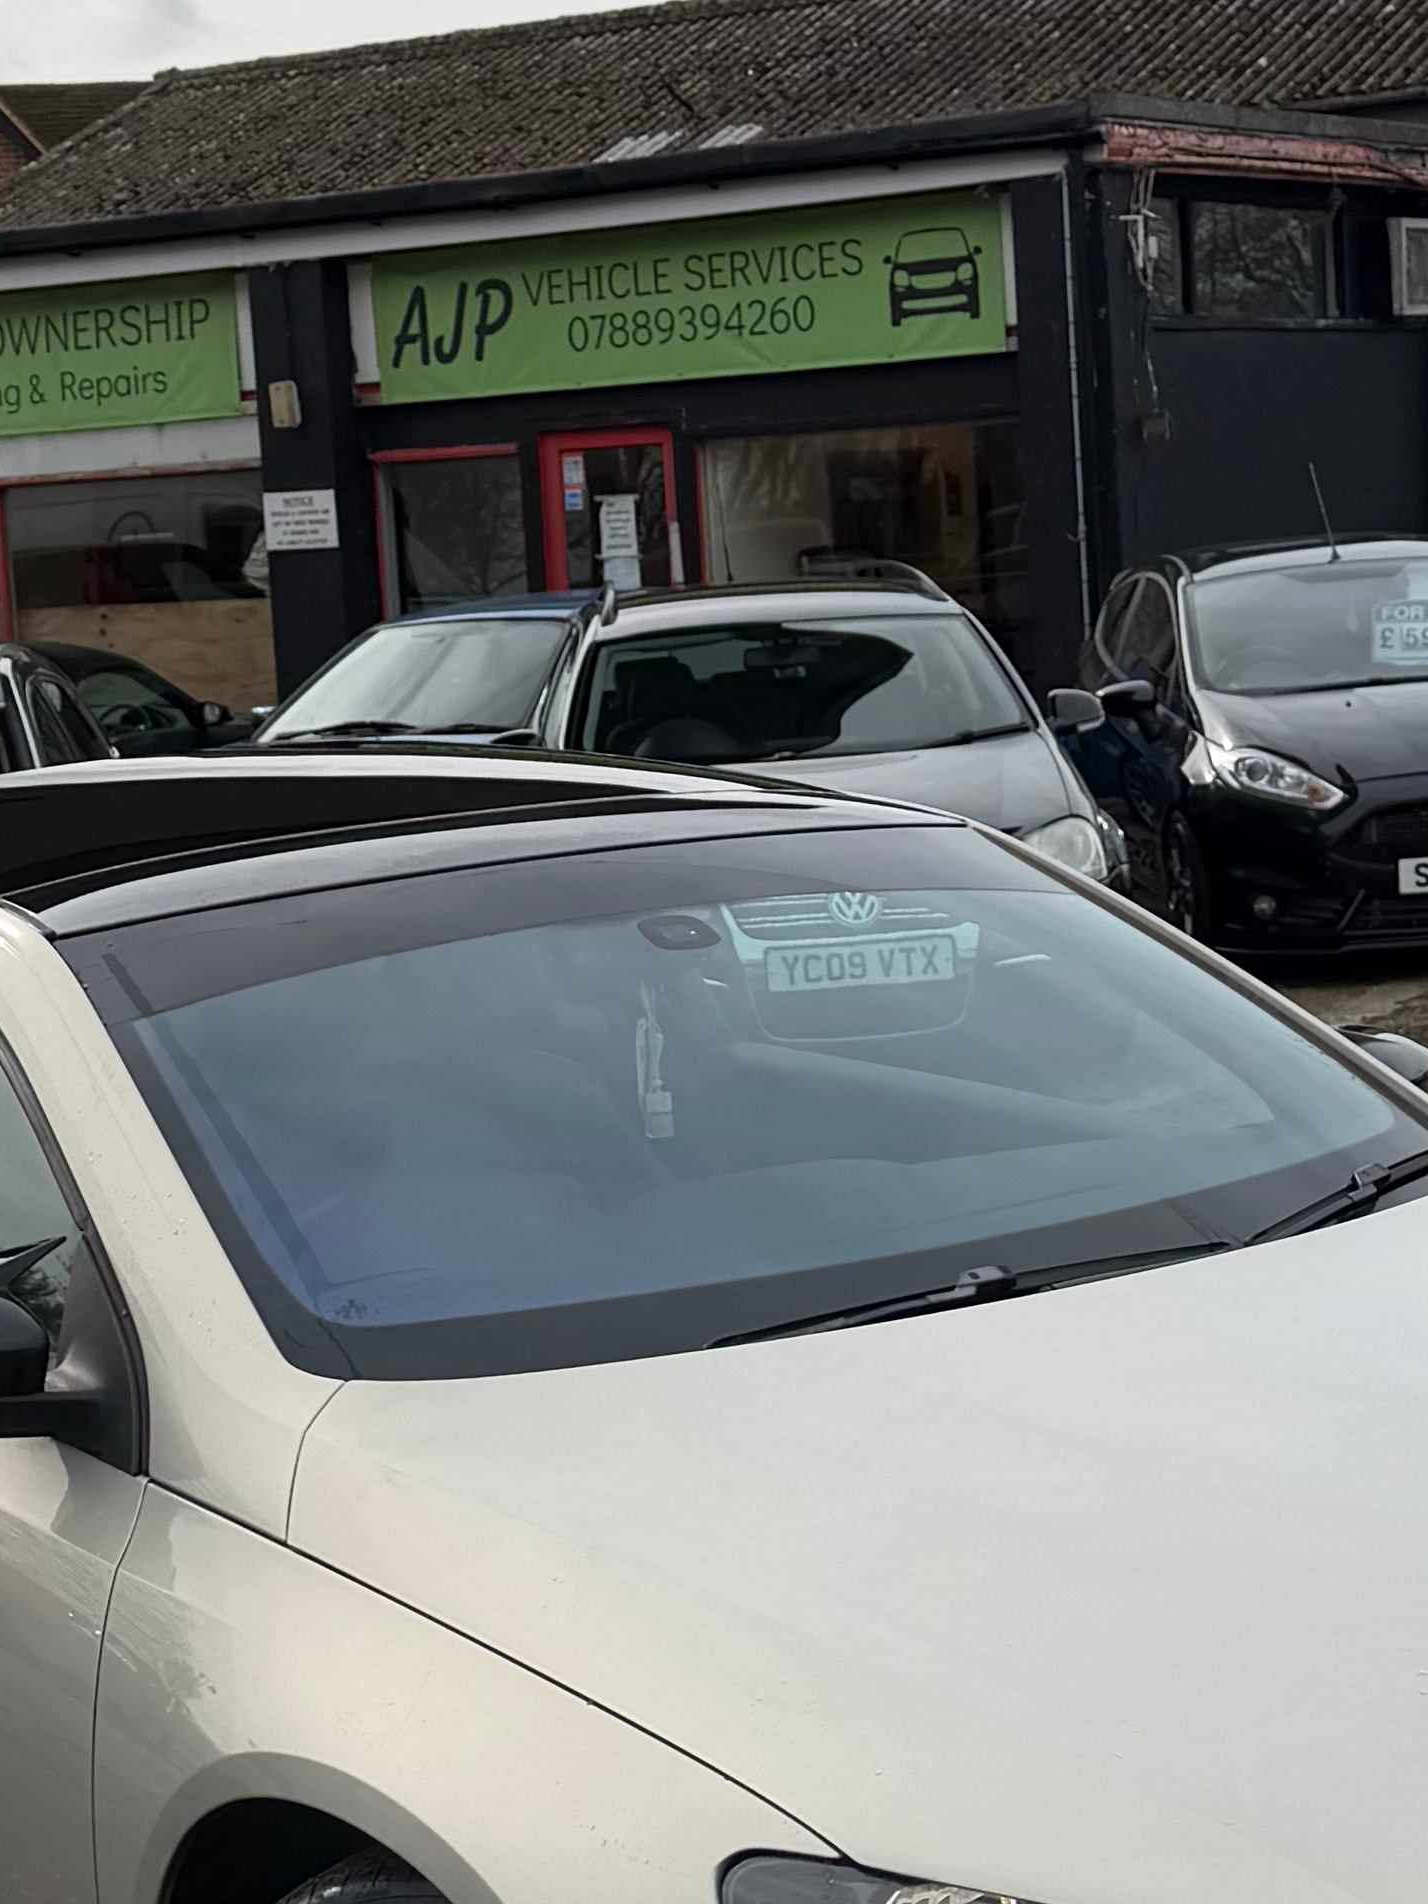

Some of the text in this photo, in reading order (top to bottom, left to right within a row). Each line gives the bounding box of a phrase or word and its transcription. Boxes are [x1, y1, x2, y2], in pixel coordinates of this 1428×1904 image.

[521, 238, 864, 306] VEHICLE SERVICES
[392, 278, 513, 368] AJP
[568, 295, 815, 352] 07889394260
[28, 374, 46, 404] &
[61, 365, 168, 406] Repairs
[1381, 604, 1425, 620] FOR
[1380, 627, 1394, 649] £
[781, 944, 940, 985] YC09 VTX
